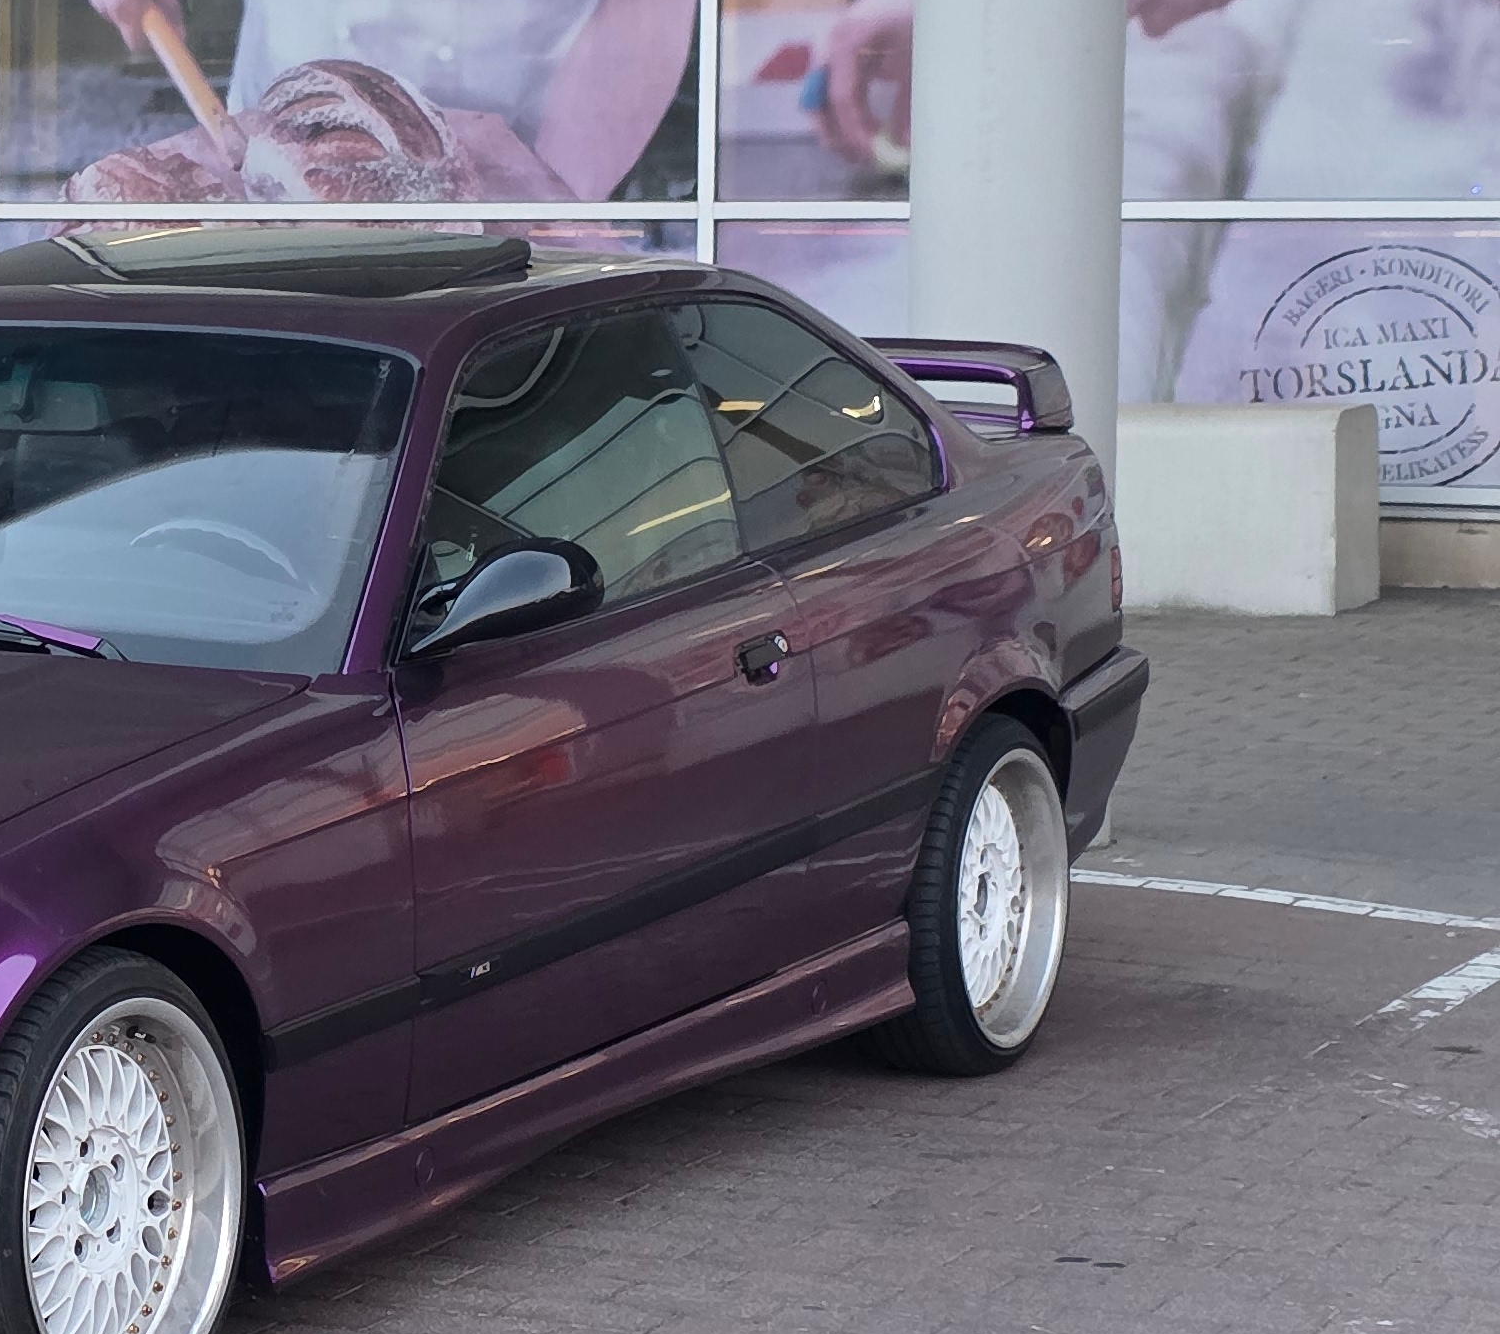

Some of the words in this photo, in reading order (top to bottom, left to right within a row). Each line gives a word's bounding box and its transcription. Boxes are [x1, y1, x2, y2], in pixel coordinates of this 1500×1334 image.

[1282, 265, 1354, 327] BAGERI
[1371, 257, 1491, 314] KONDITORI
[1323, 326, 1370, 350] ICA
[1377, 317, 1451, 345] MAXI
[1381, 425, 1489, 482] ELIKATESS
